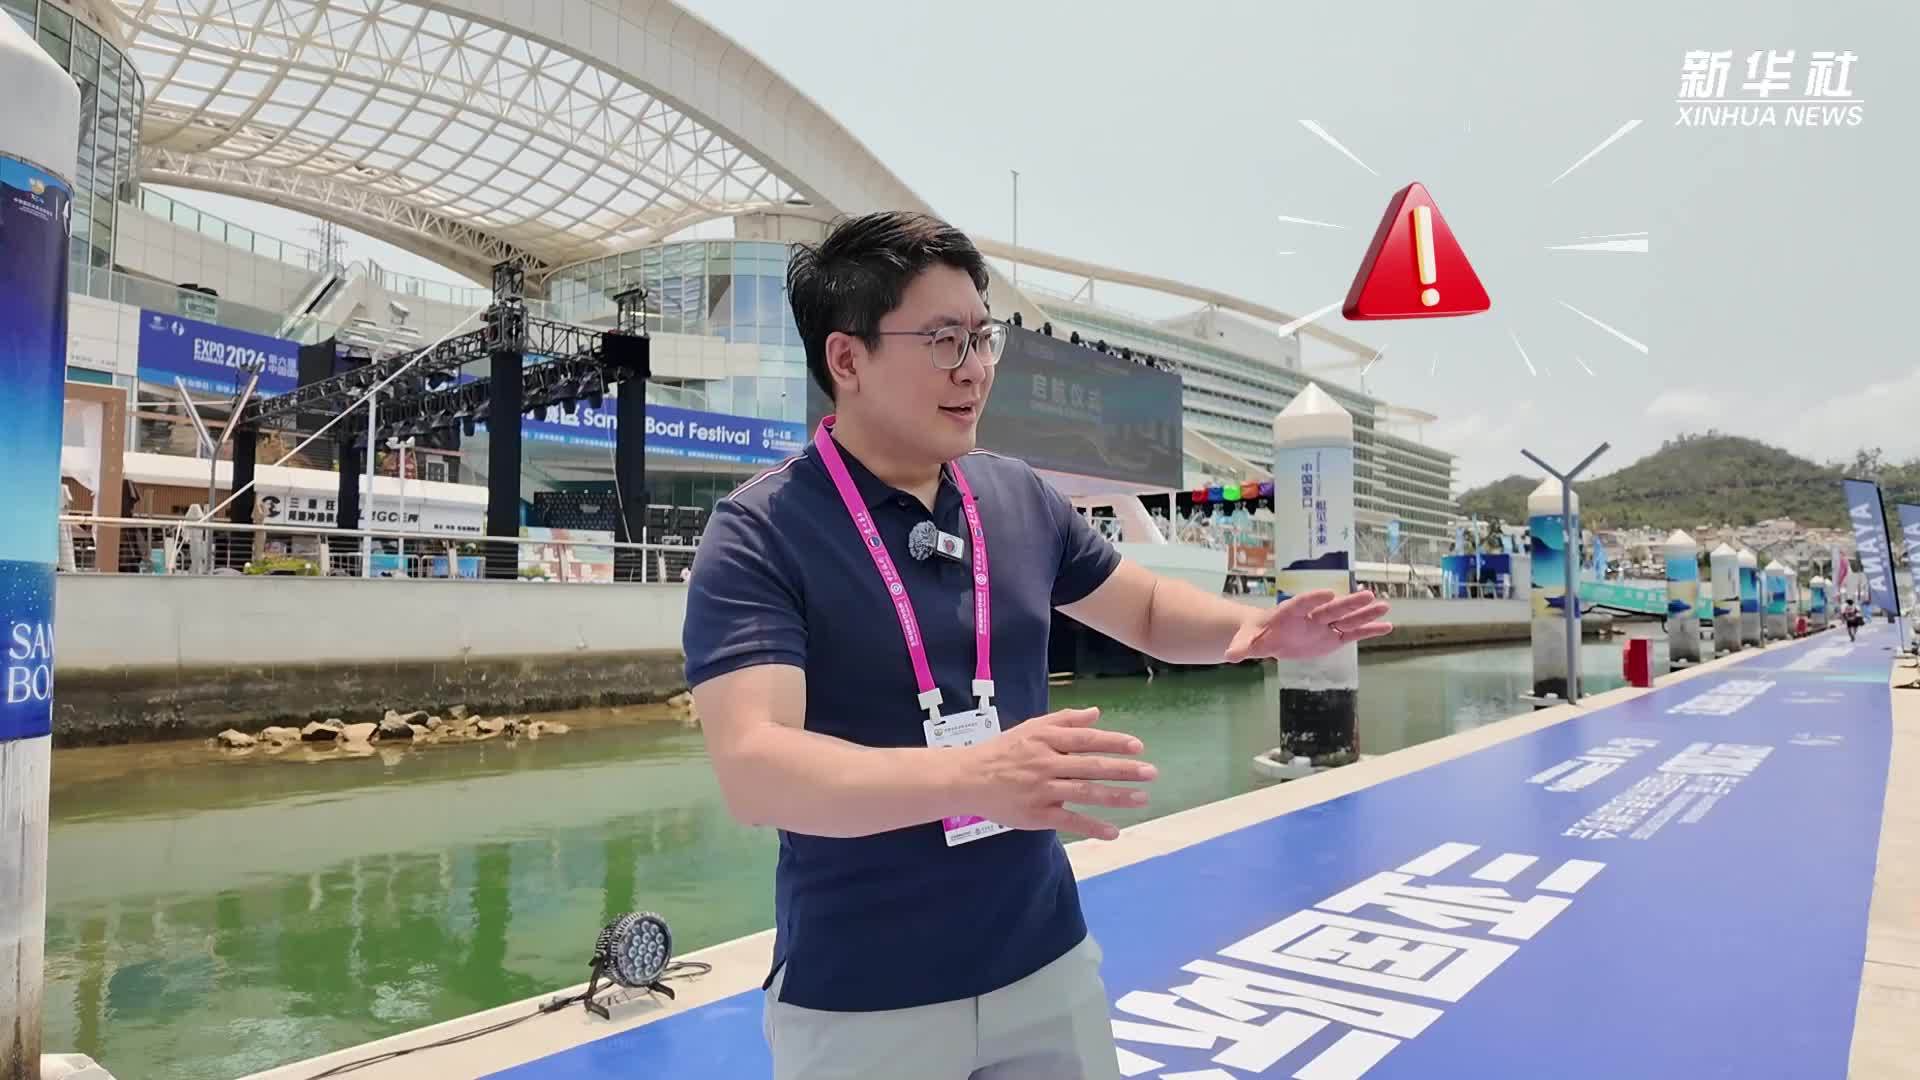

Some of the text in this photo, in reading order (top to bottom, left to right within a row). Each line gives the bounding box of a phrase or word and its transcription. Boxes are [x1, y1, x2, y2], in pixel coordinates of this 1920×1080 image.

[194, 338, 225, 359] EXPO
[225, 345, 267, 373] 2026
[583, 407, 618, 430] San
[645, 416, 684, 438] Boat
[688, 422, 750, 446] Festival
[1101, 842, 1608, 1079] 三亚国际
